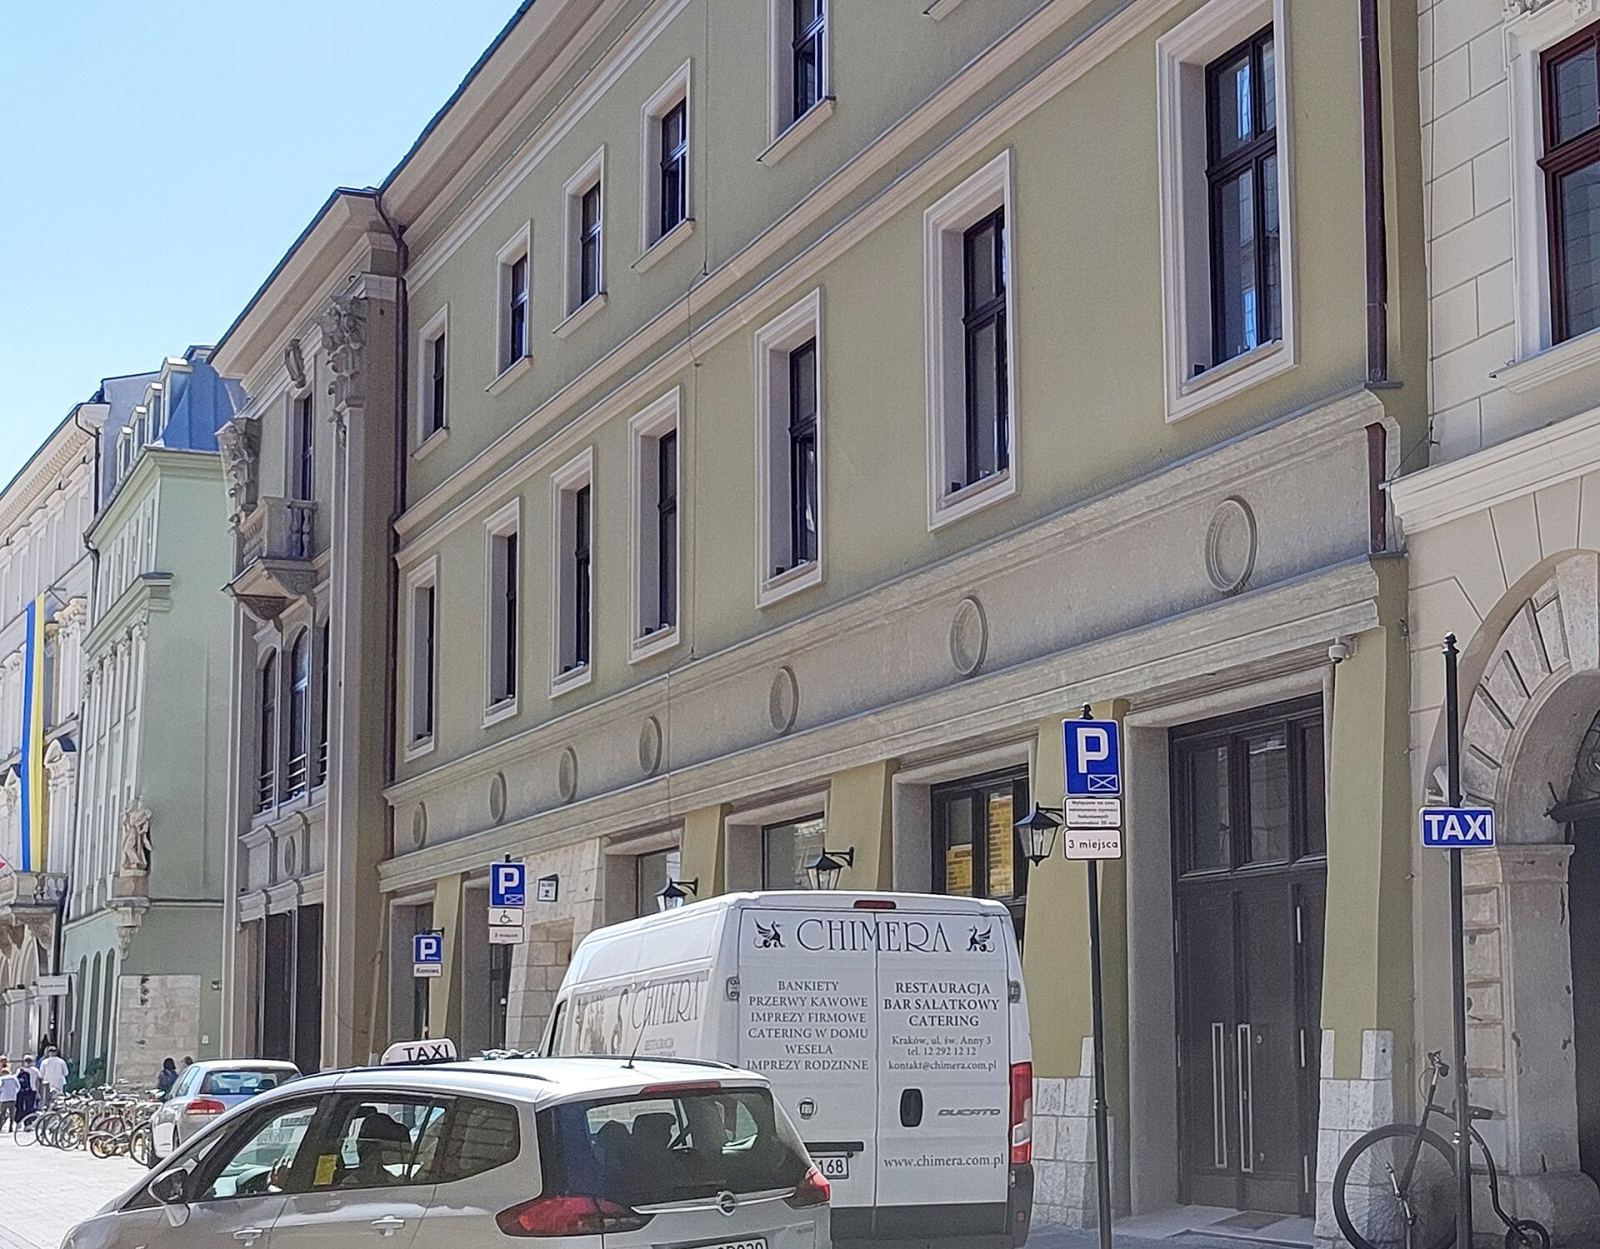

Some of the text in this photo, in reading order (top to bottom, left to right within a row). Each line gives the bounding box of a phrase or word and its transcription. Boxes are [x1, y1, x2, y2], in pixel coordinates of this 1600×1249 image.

[1077, 727, 1109, 773] P
[1425, 815, 1492, 840] TAXI
[1068, 838, 1118, 851] 3 miejsca
[499, 868, 520, 895] P
[797, 918, 952, 952] CHIMERA
[420, 939, 437, 960] P
[778, 980, 839, 992] BANKIETY
[895, 982, 991, 995] RESTAURACJA
[749, 996, 868, 1008] PRZERWY KAWOWE
[884, 999, 1000, 1011] BAR SAŁATKOWY
[751, 1012, 866, 1023] IMPREZY FIRMOWE
[909, 1015, 979, 1027] CATERING
[748, 1028, 869, 1039] CATERING W DOMU
[892, 1036, 930, 1047] Kraków,
[960, 1036, 984, 1047] Anny
[985, 1036, 991, 1046] 3
[403, 1044, 449, 1062] TAXI
[785, 1044, 834, 1055] WESELA
[907, 1046, 977, 1056] tel. 12 292 12 12
[746, 1060, 869, 1071] IMPREZY RODZINNE
[888, 1060, 997, 1072] kontakt@chimera.com.pl
[938, 1108, 1001, 1117] DUCATO
[811, 1159, 844, 1174] 168
[884, 1153, 1005, 1169] www.chimera.com.pl
